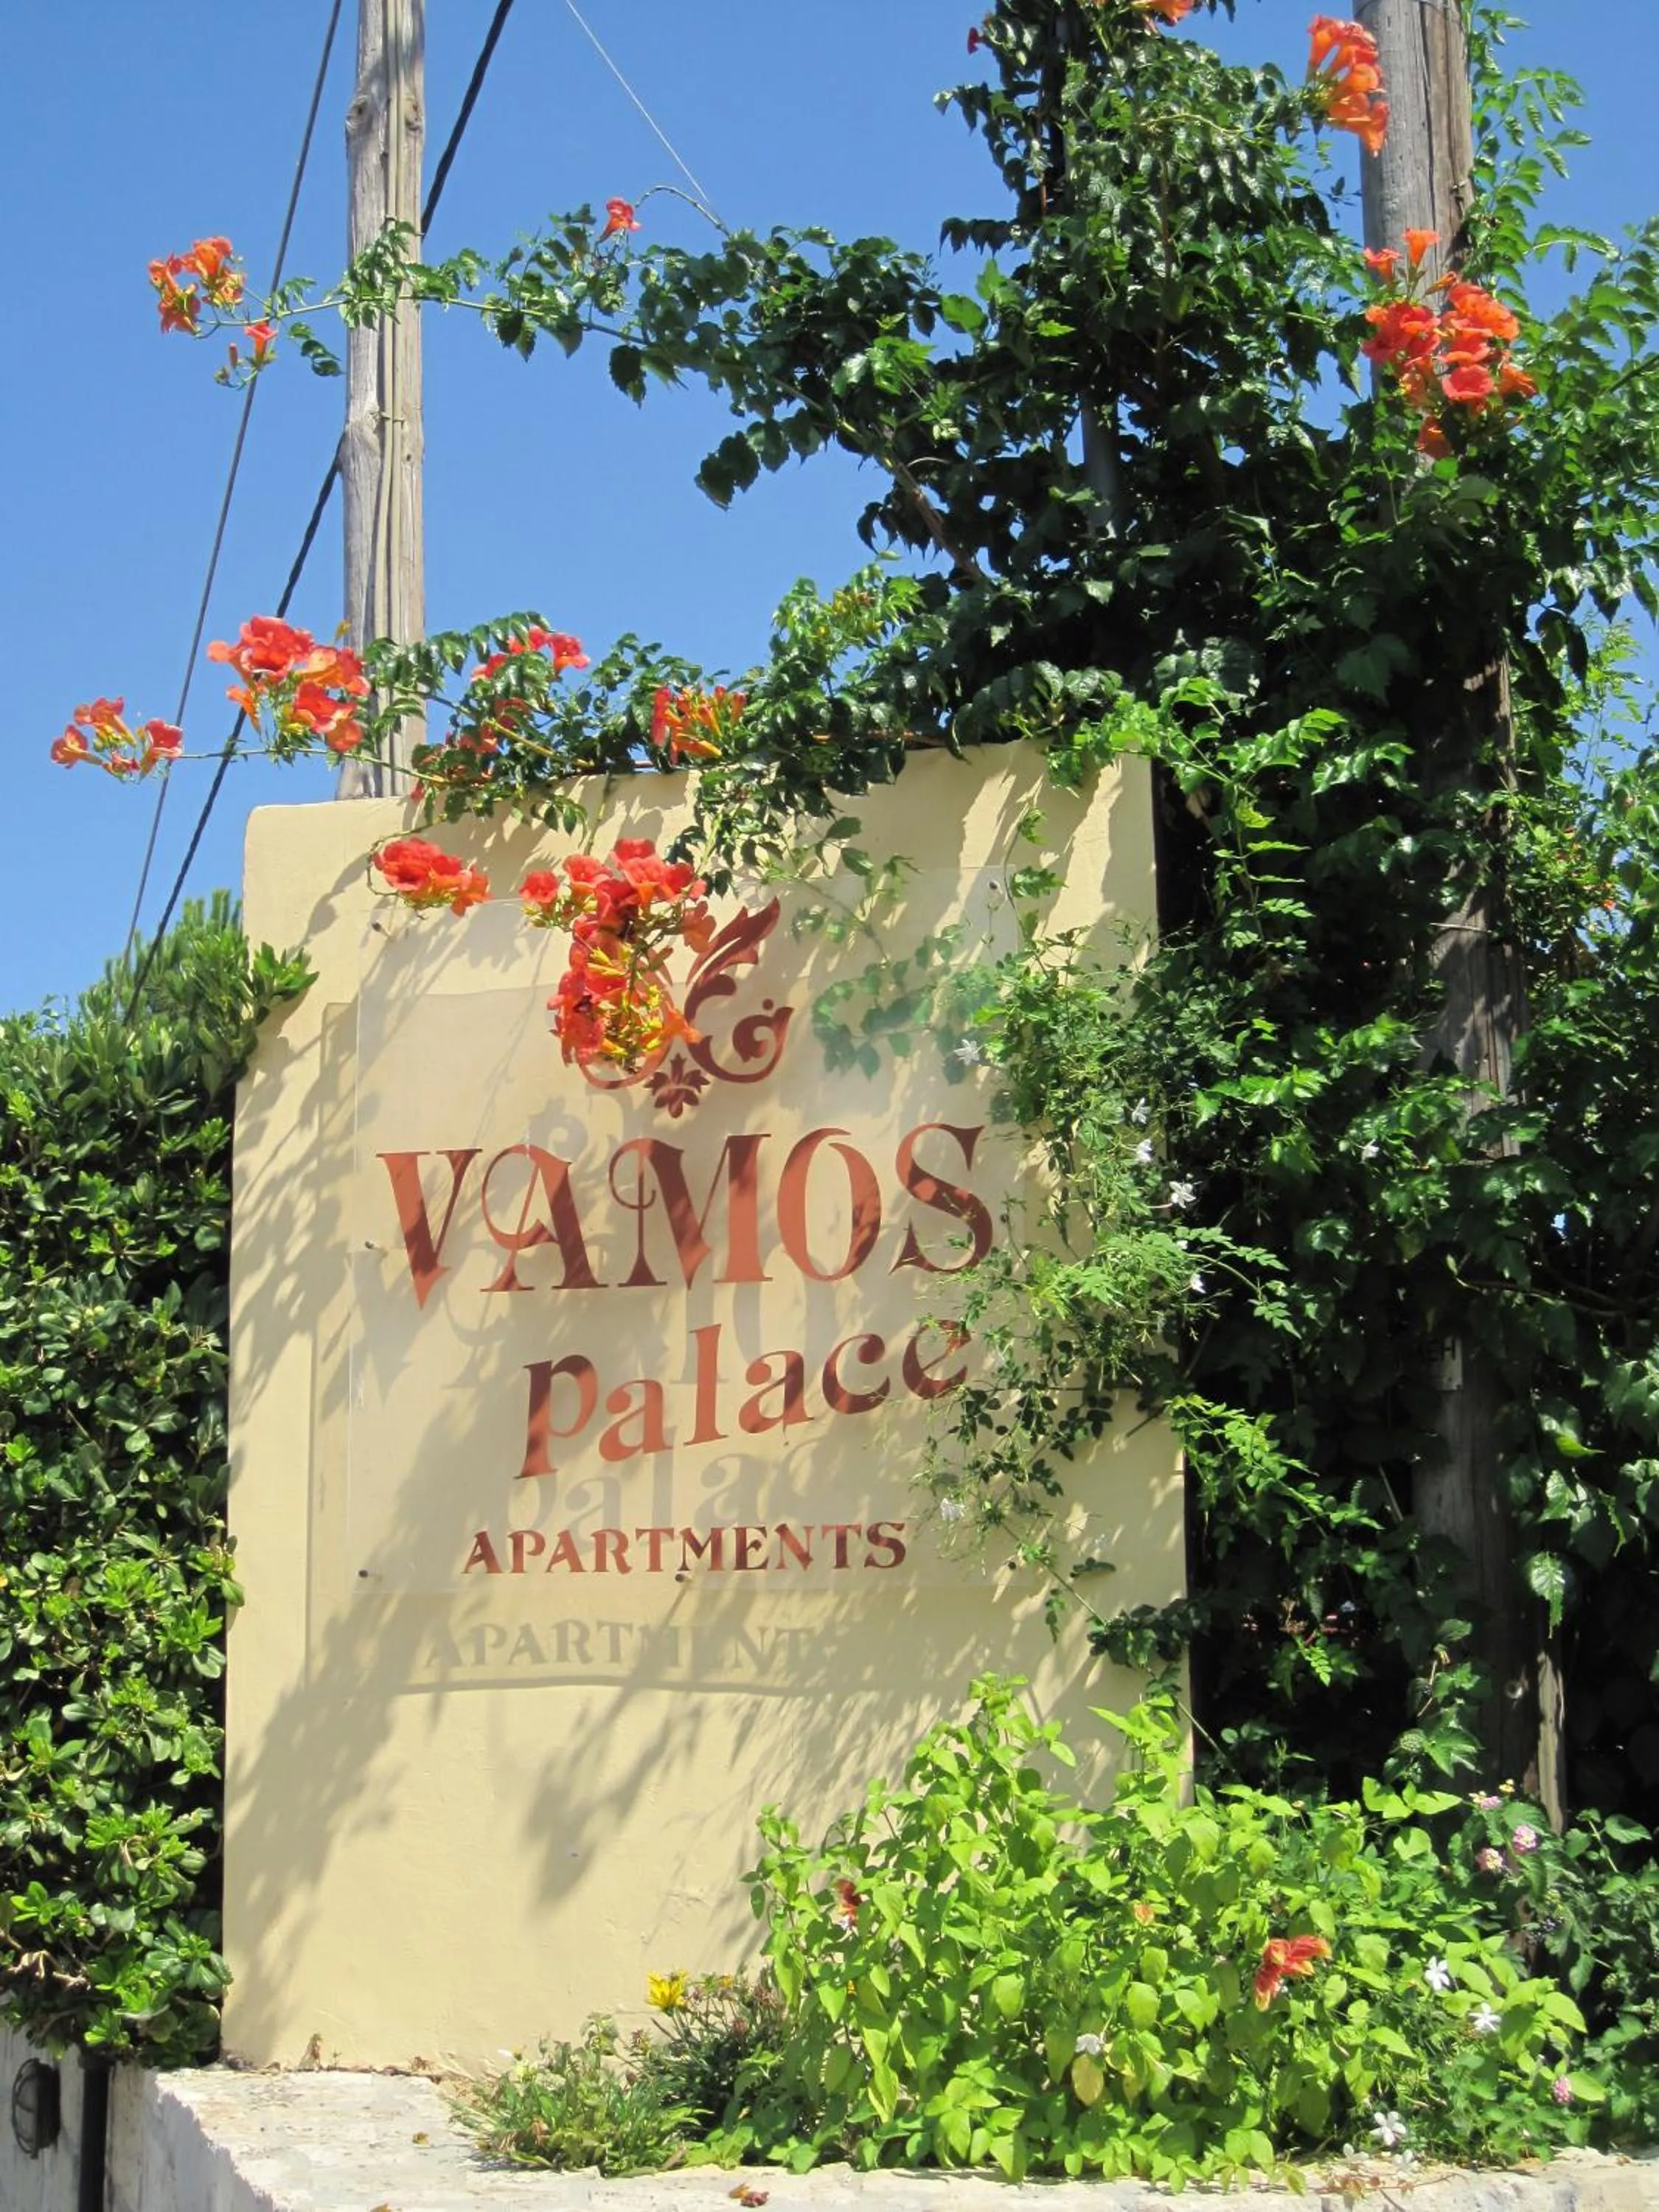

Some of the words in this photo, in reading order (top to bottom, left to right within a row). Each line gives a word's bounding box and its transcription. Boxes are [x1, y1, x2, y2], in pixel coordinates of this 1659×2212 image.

[376, 1123, 993, 1310] VAMOS
[515, 1319, 973, 1479] palace
[461, 1522, 907, 1575] APARTMENTS
